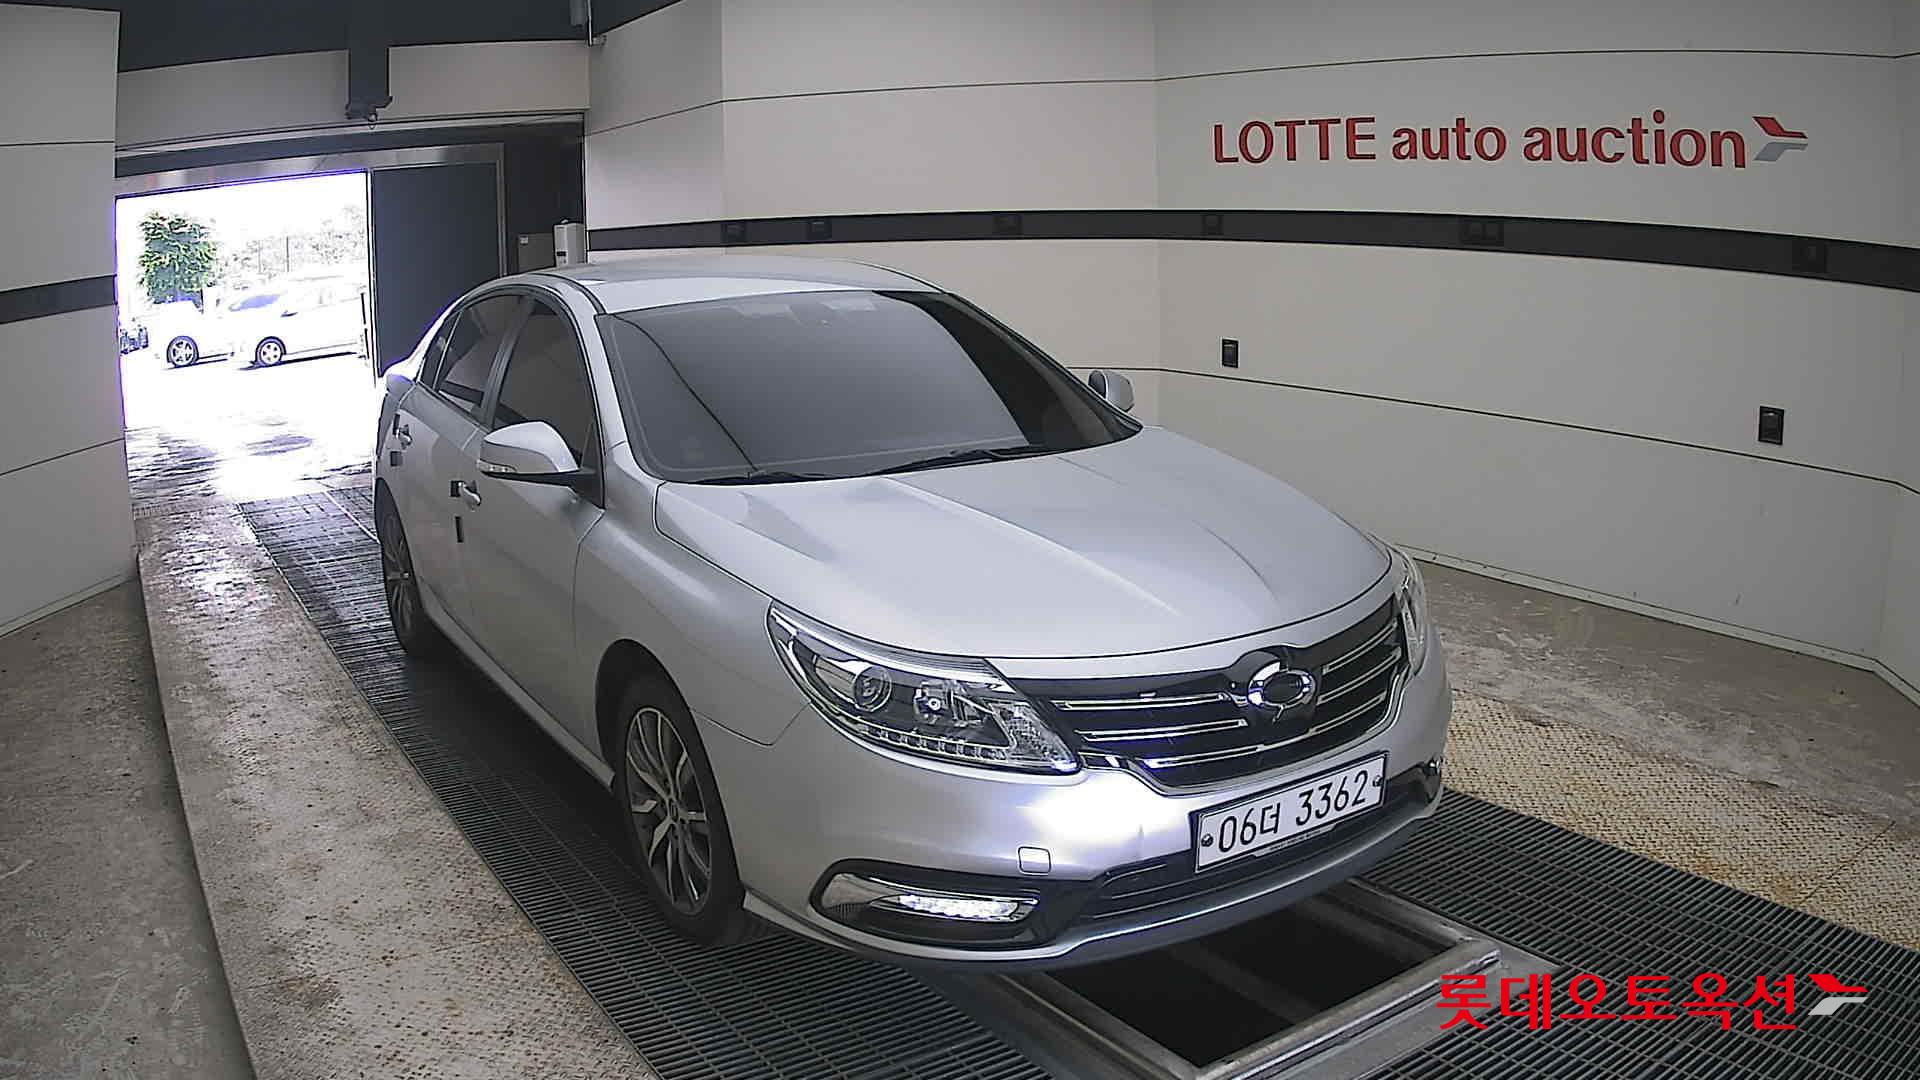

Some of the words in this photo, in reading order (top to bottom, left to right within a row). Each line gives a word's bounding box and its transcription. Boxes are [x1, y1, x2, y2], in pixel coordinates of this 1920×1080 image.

[1213, 117, 1376, 164] LOTTE
[1391, 117, 1508, 162] auto
[1522, 109, 1746, 168] auction
[1218, 802, 1281, 853] 06더
[1295, 770, 1369, 826] 3362
